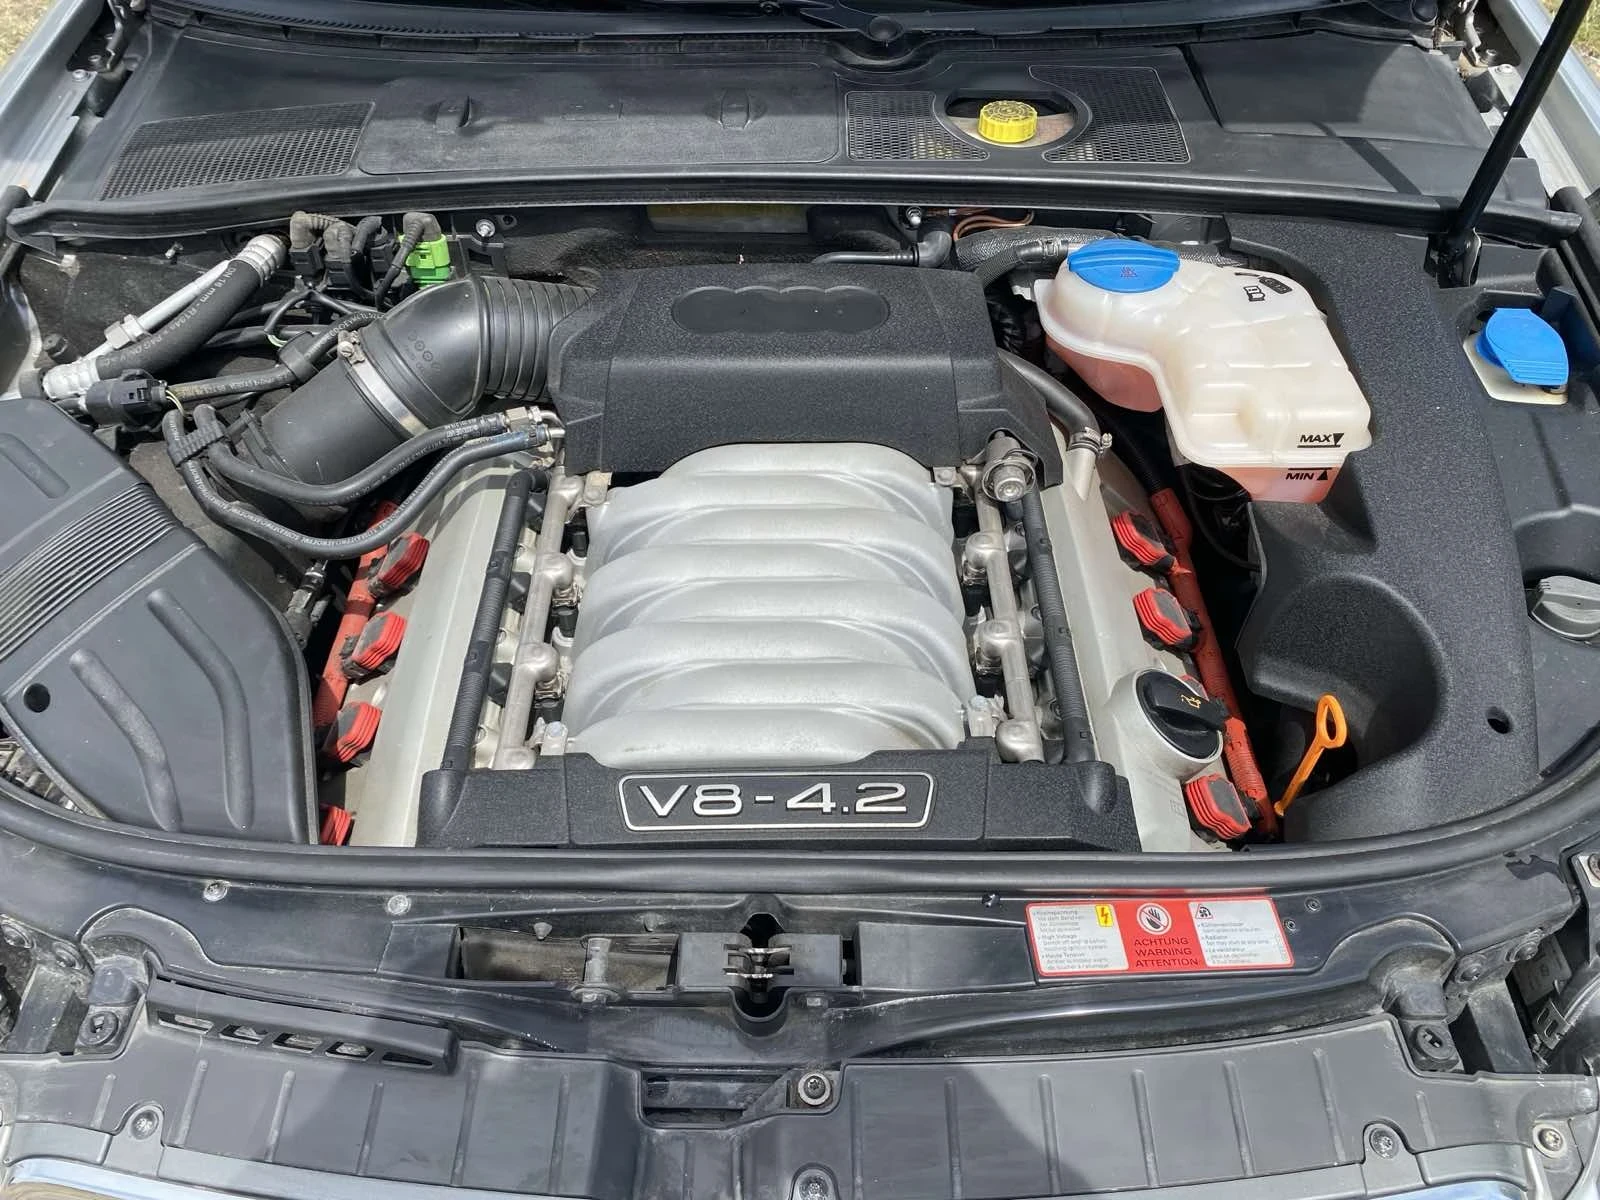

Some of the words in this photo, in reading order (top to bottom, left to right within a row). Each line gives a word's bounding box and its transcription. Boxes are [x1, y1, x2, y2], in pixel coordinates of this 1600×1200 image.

[1300, 434, 1332, 443] MAX
[1134, 937, 1189, 947] ACHTUNG
[1135, 947, 1192, 957] WARNING
[1136, 958, 1198, 968] ATTENTION
